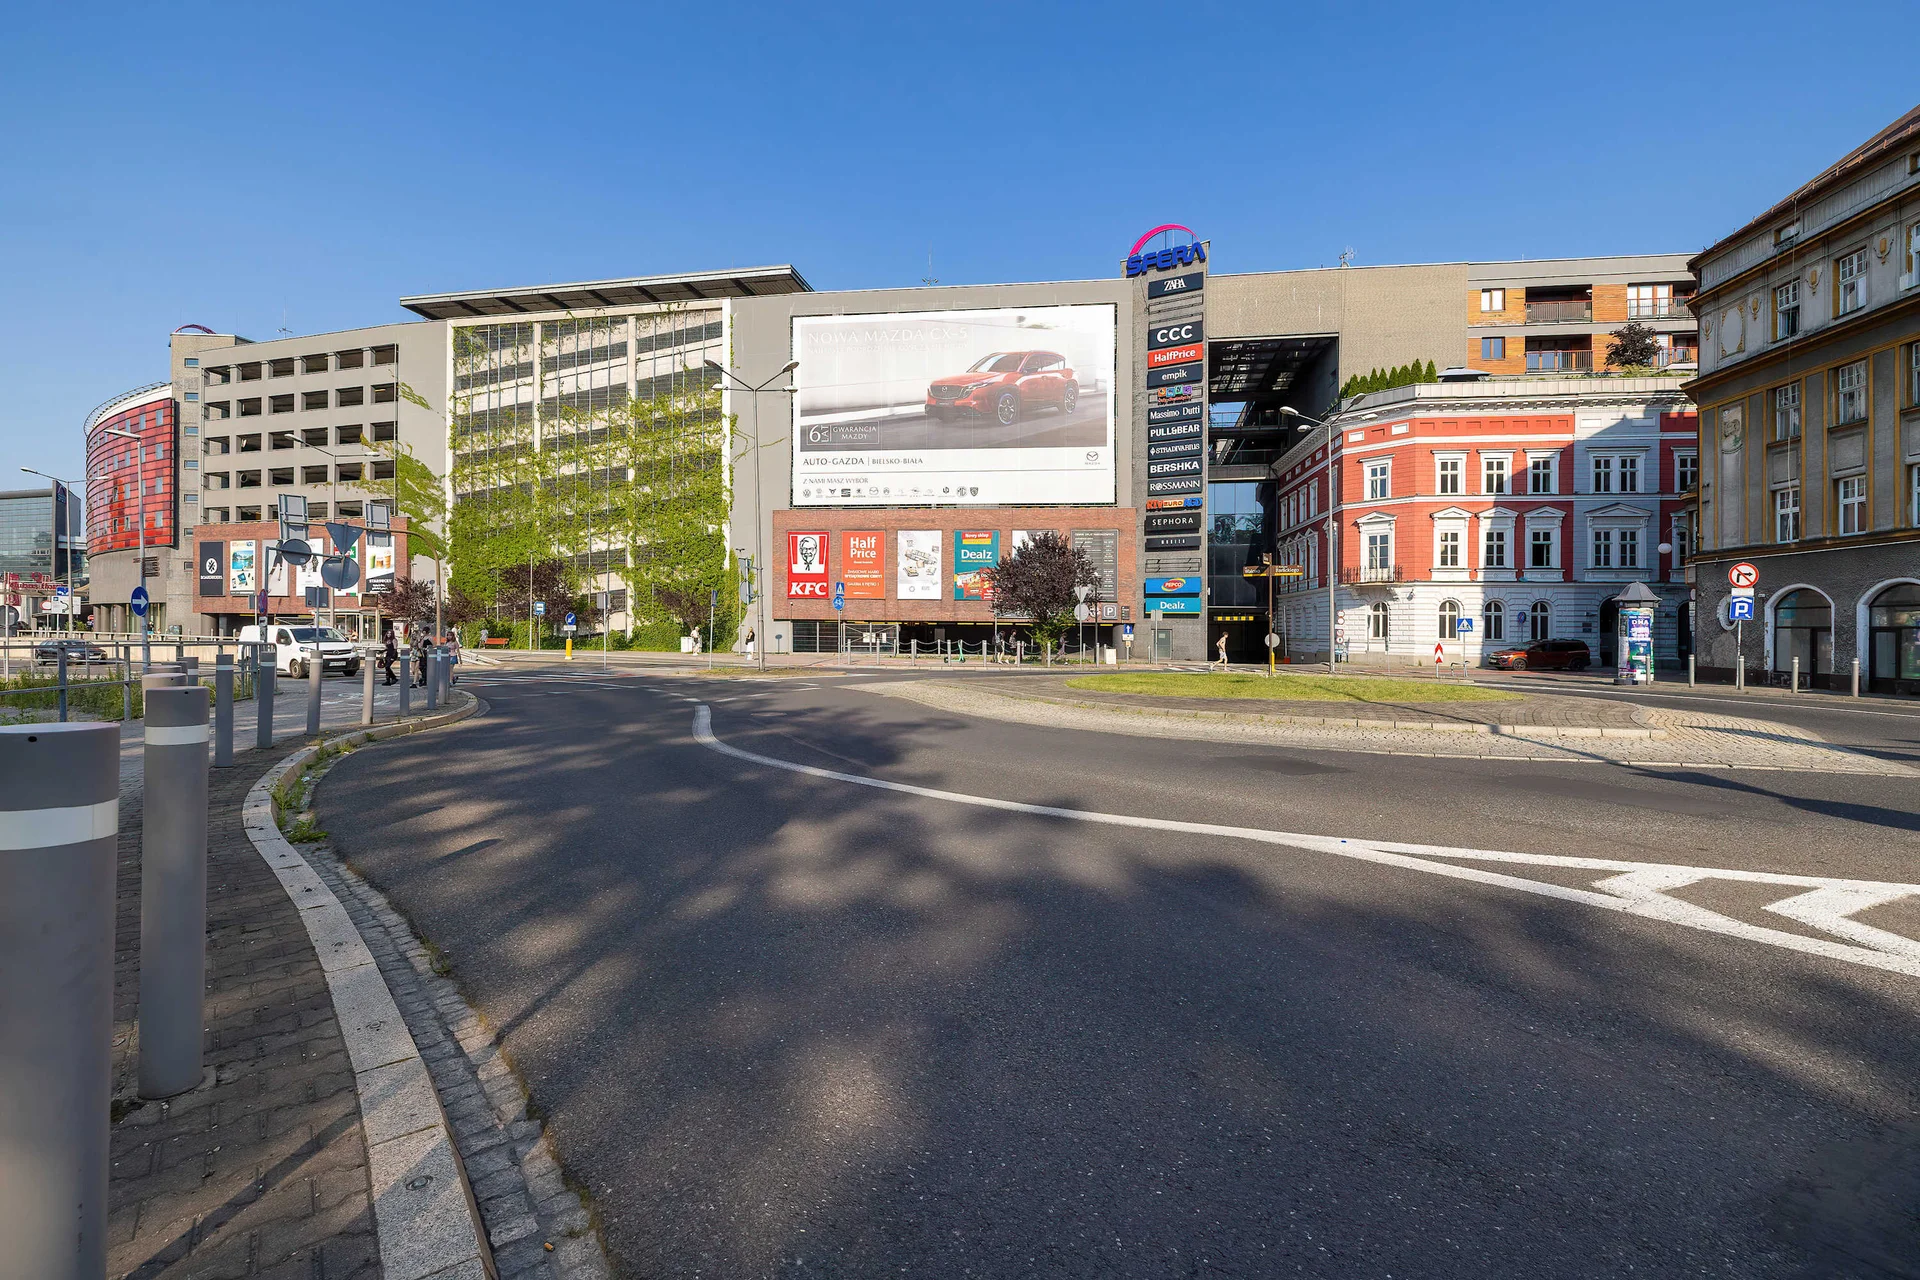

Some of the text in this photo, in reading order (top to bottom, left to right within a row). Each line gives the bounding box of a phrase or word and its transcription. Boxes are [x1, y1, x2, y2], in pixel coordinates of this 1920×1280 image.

[1126, 241, 1206, 276] SFERA
[1163, 278, 1187, 292] ZARA
[808, 331, 859, 345] NOWA
[864, 329, 924, 343] MAZDA
[1156, 325, 1193, 343] CCC
[1154, 349, 1196, 363] HalfPrice
[1161, 369, 1188, 380] empik
[1150, 405, 1201, 420] Massimo Dutti
[809, 425, 821, 443] 6
[1150, 423, 1200, 437] PULL&BEAR
[802, 457, 865, 466] AUTO-GAZDA
[1150, 461, 1200, 473] BERSHKA
[1150, 480, 1200, 491] ROSSMANN
[1152, 517, 1194, 526] SEPHORA
[850, 536, 877, 549] Half
[850, 548, 877, 559] Price
[961, 549, 993, 560] Dealz
[789, 582, 828, 595] KFC
[1106, 607, 1114, 616] P
[1160, 601, 1186, 610] Dealz
[1735, 602, 1749, 617] P
